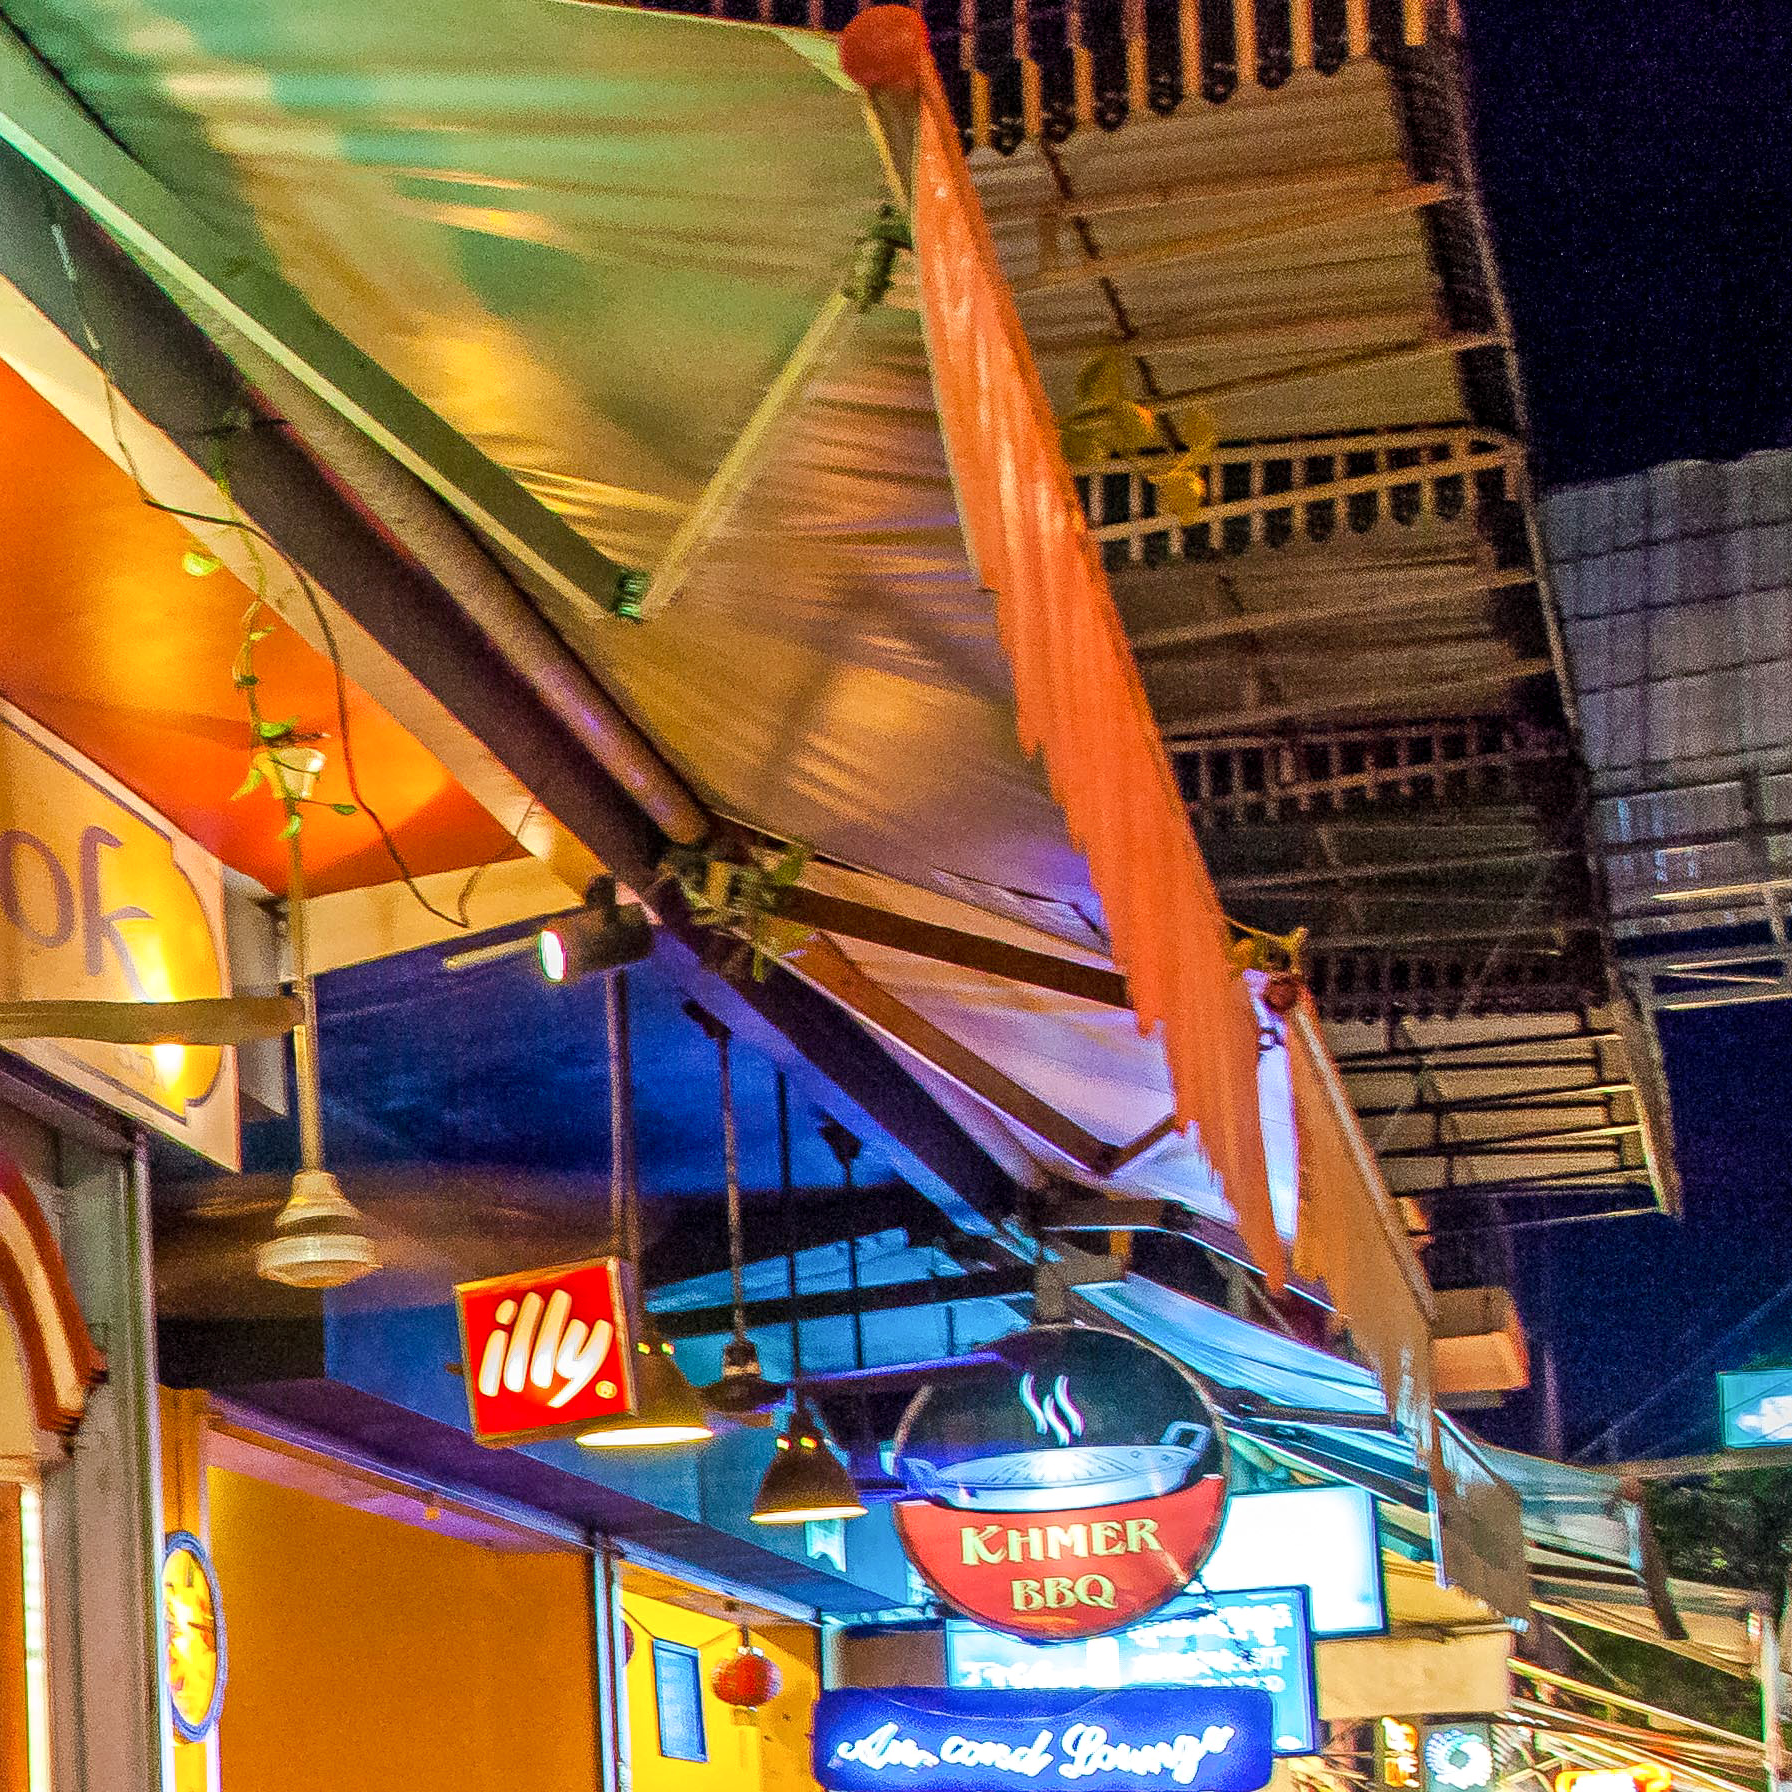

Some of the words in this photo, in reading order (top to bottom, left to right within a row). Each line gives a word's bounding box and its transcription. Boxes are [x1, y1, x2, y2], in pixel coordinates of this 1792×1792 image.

[478, 1288, 614, 1409] illy
[959, 1518, 1164, 1568] KHMER
[1011, 1574, 1118, 1612] BBQ
